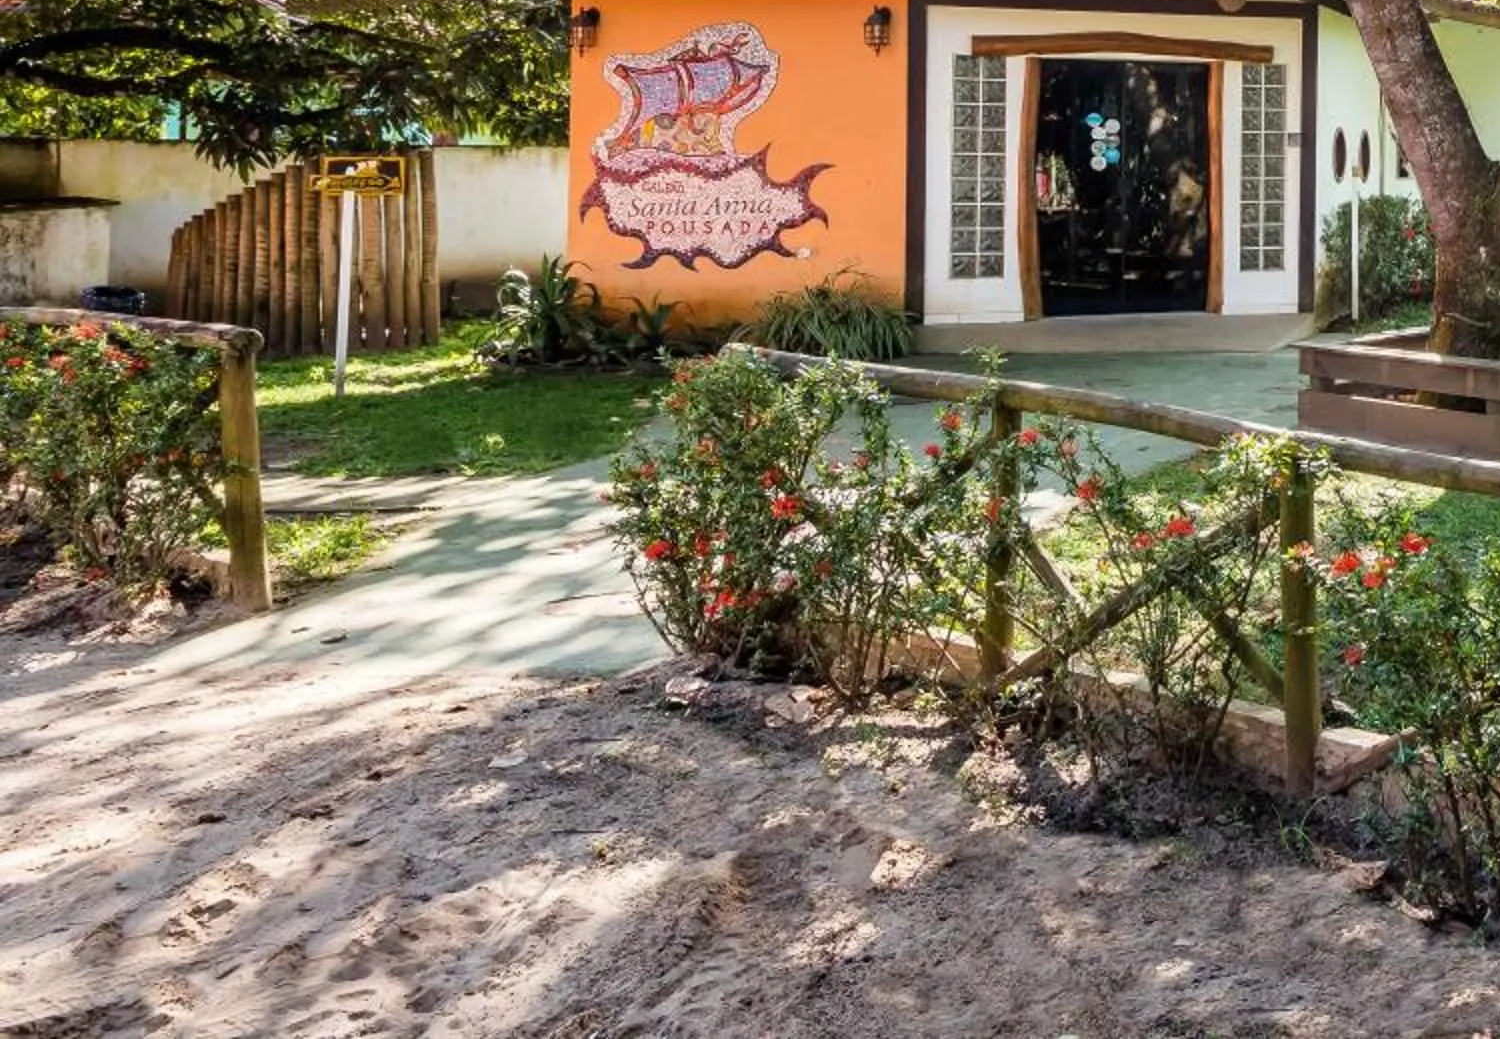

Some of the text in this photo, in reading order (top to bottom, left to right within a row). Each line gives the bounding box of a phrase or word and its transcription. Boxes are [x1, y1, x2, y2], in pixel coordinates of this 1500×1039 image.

[627, 197, 773, 218] Santa Anna
[646, 220, 772, 236] POUSADA
